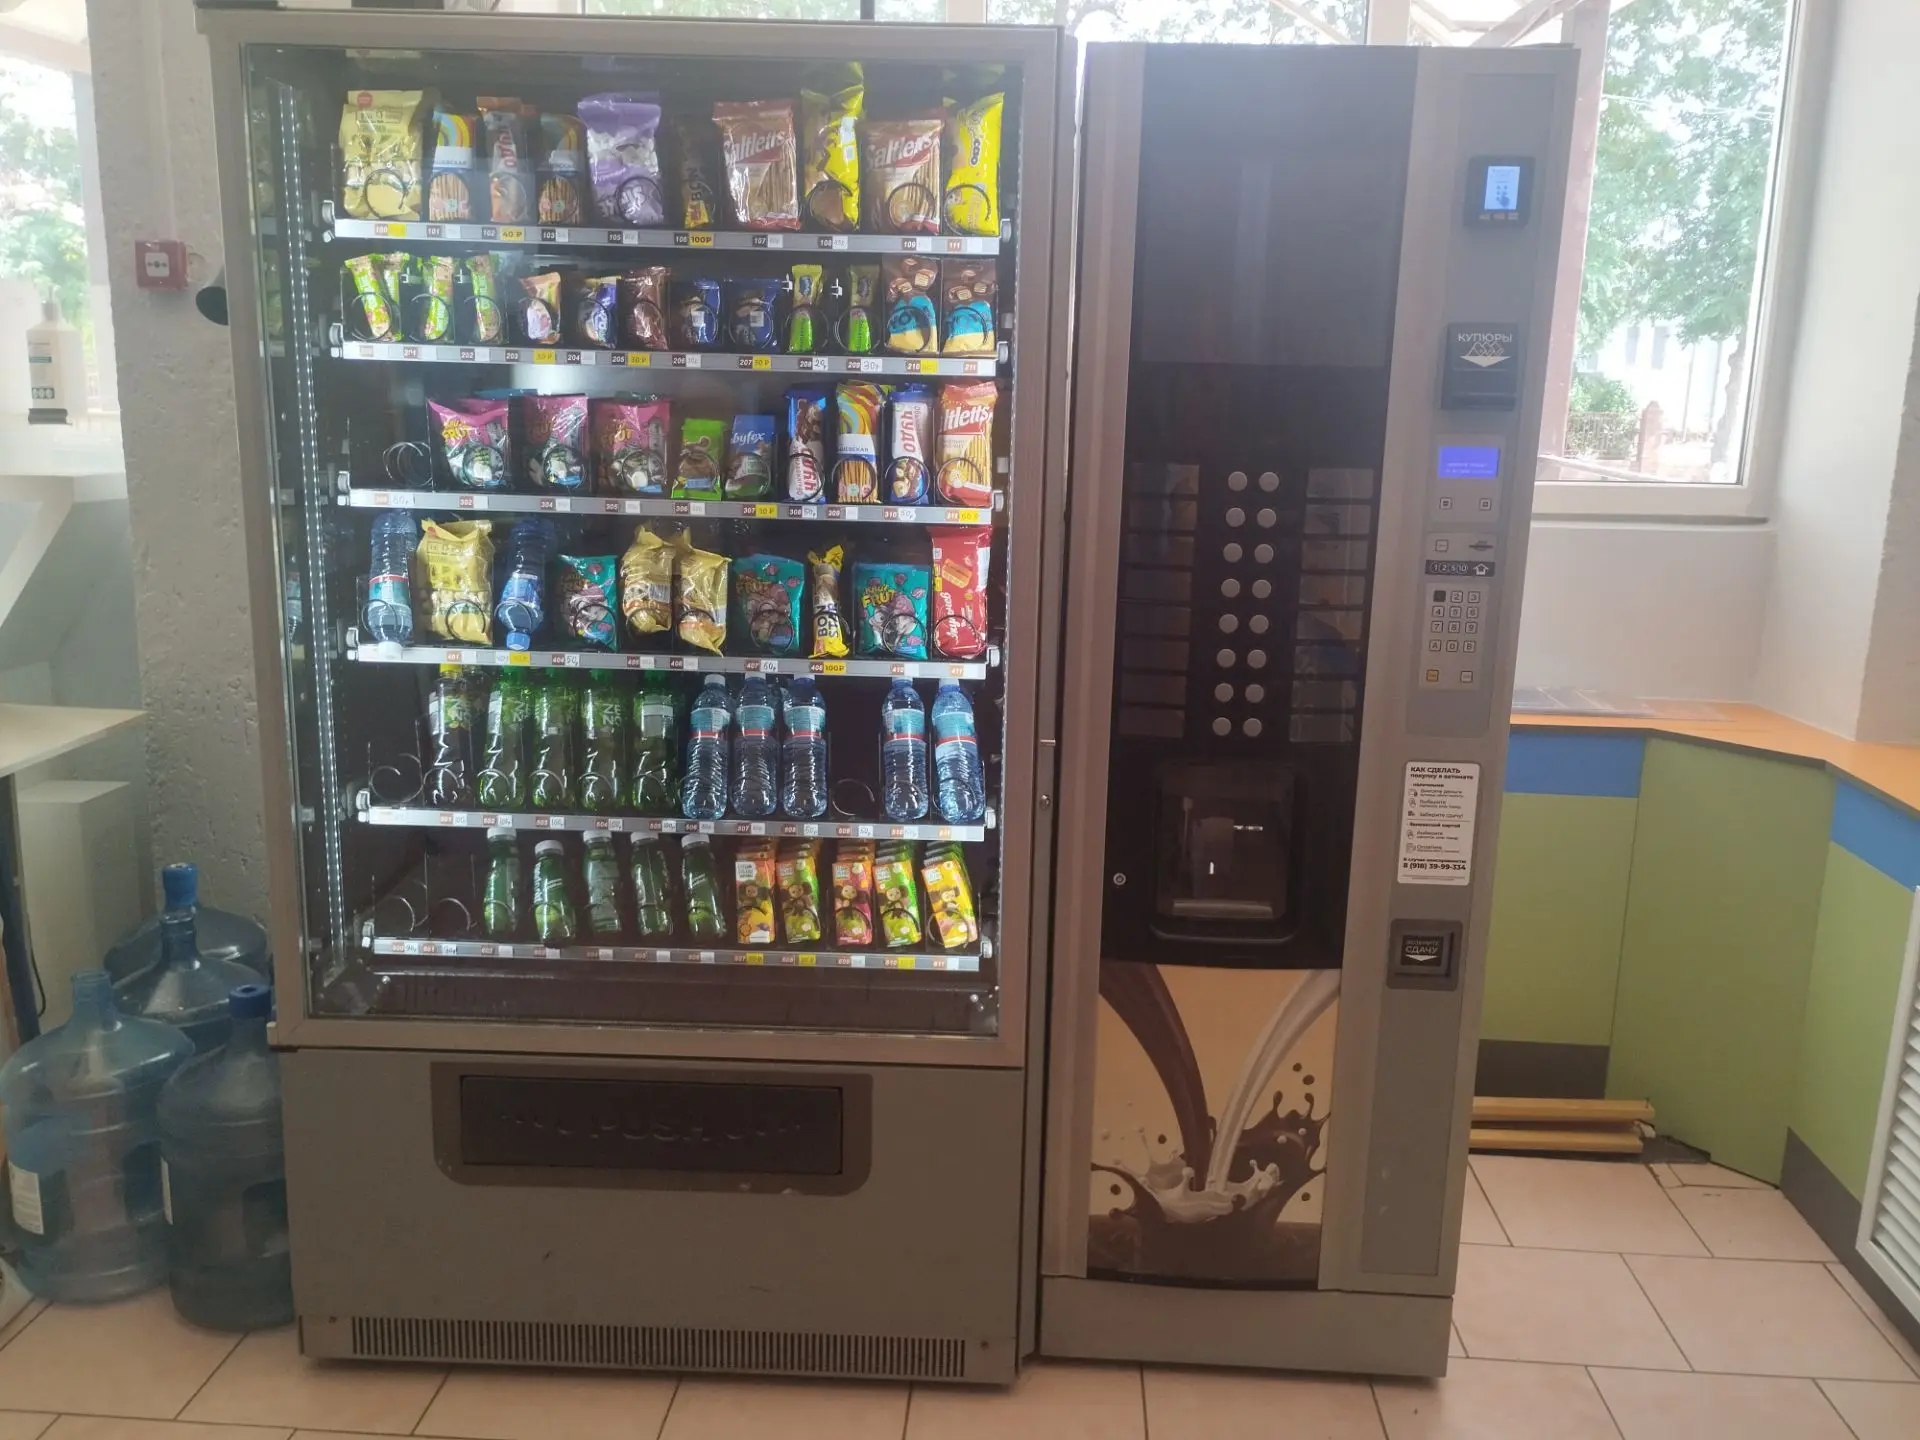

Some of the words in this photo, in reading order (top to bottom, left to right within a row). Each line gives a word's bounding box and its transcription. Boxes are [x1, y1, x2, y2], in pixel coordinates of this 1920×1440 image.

[484, 228, 495, 236] 102
[1457, 332, 1512, 343] КУПЮРЫ
[461, 351, 474, 359] 202
[567, 353, 580, 361] 204
[460, 498, 472, 506] 302
[816, 605, 828, 637] BON
[1405, 945, 1438, 954] СДАЧУ
